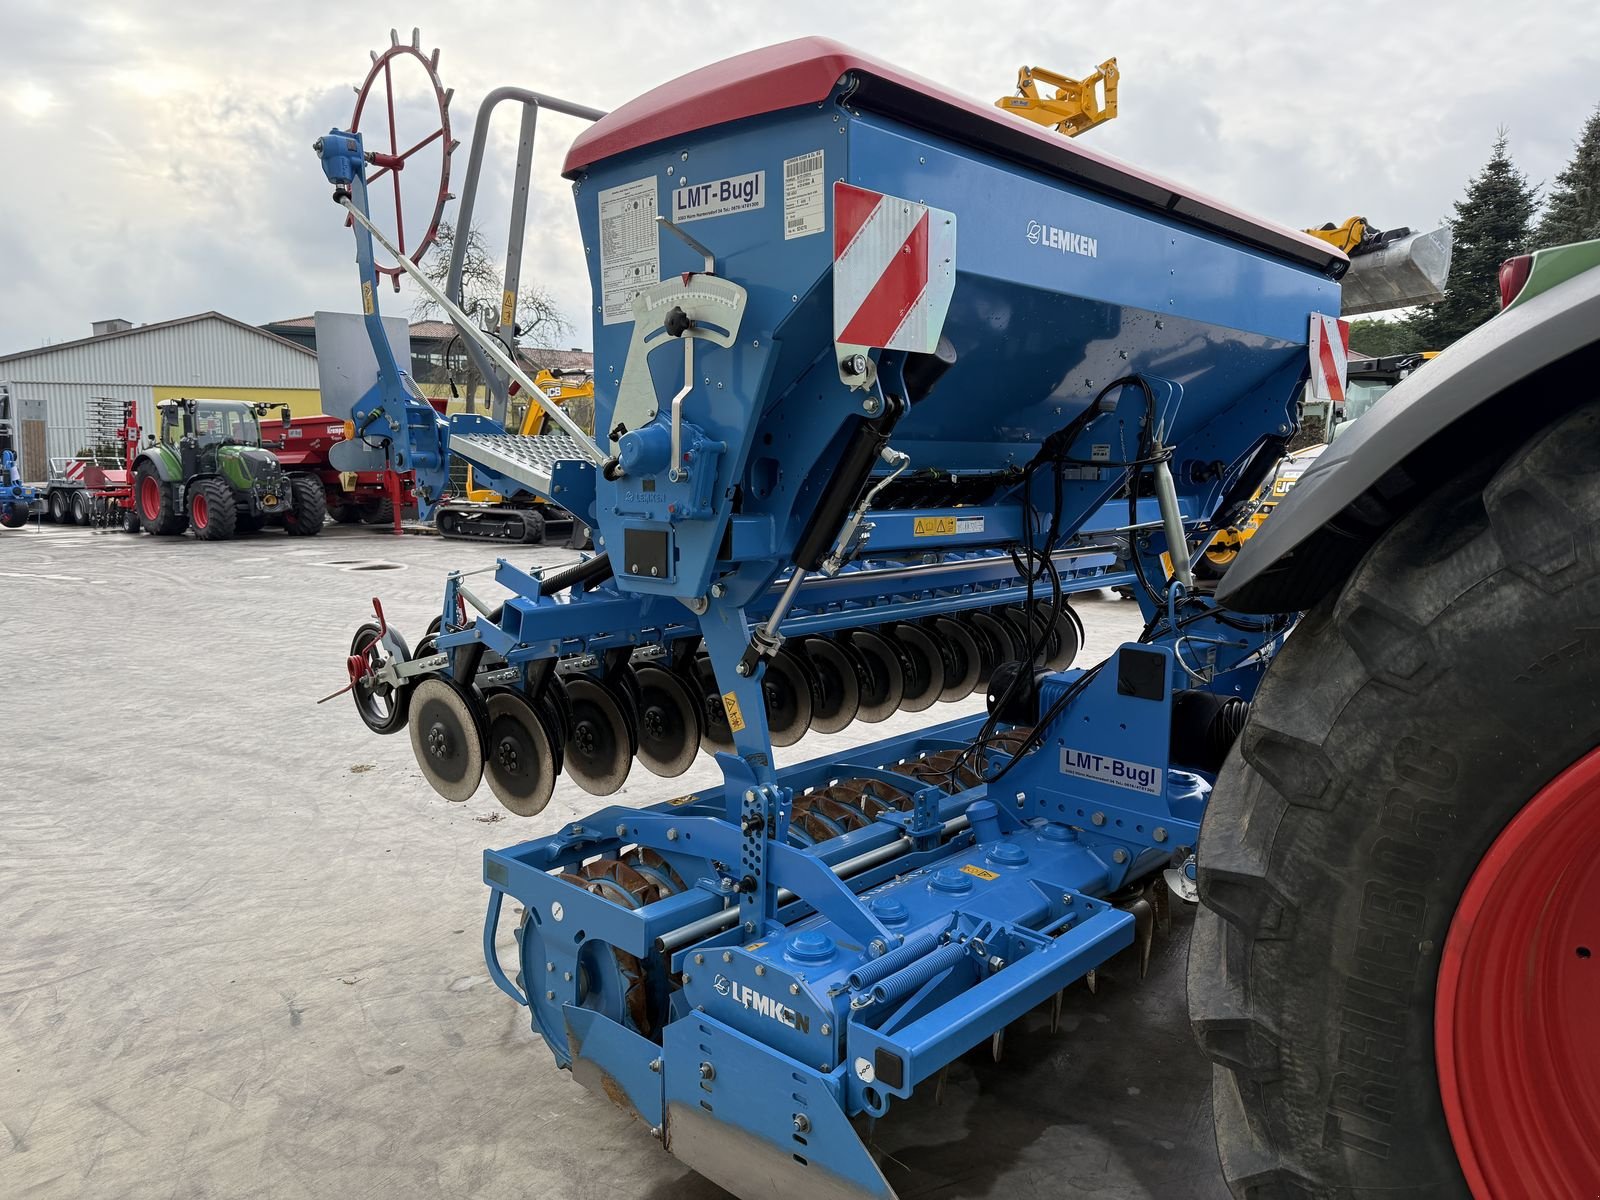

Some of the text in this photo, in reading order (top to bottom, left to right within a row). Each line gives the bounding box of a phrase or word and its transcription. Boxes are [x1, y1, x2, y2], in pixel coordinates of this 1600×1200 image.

[677, 174, 759, 210] LMT-Bugl
[1042, 225, 1098, 258] LEMKEN
[1276, 481, 1296, 493] JC
[1065, 750, 1155, 787] LMT-Bugl
[1321, 735, 1462, 1159] TRELLEBORG
